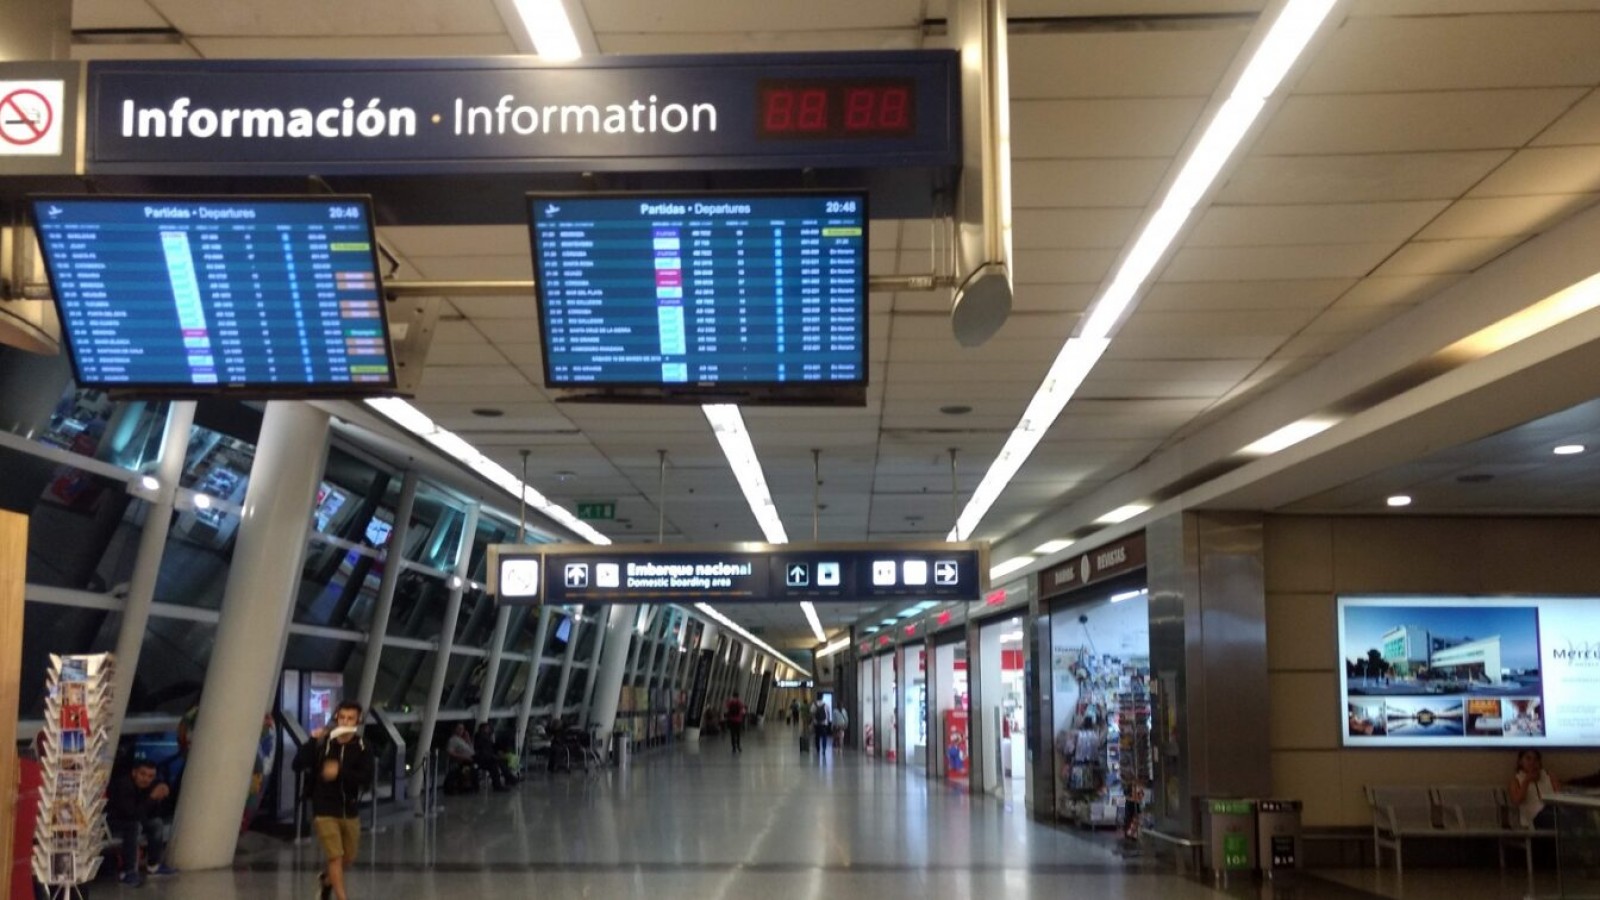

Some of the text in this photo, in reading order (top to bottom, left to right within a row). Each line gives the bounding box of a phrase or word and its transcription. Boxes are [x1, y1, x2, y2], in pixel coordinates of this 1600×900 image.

[121, 95, 718, 138] Información Information
[144, 206, 256, 220] Partidas Departures
[641, 203, 751, 217] Partidas Departures
[627, 562, 752, 578] Embarque nacional
[627, 577, 732, 589] Domestic boarding area
